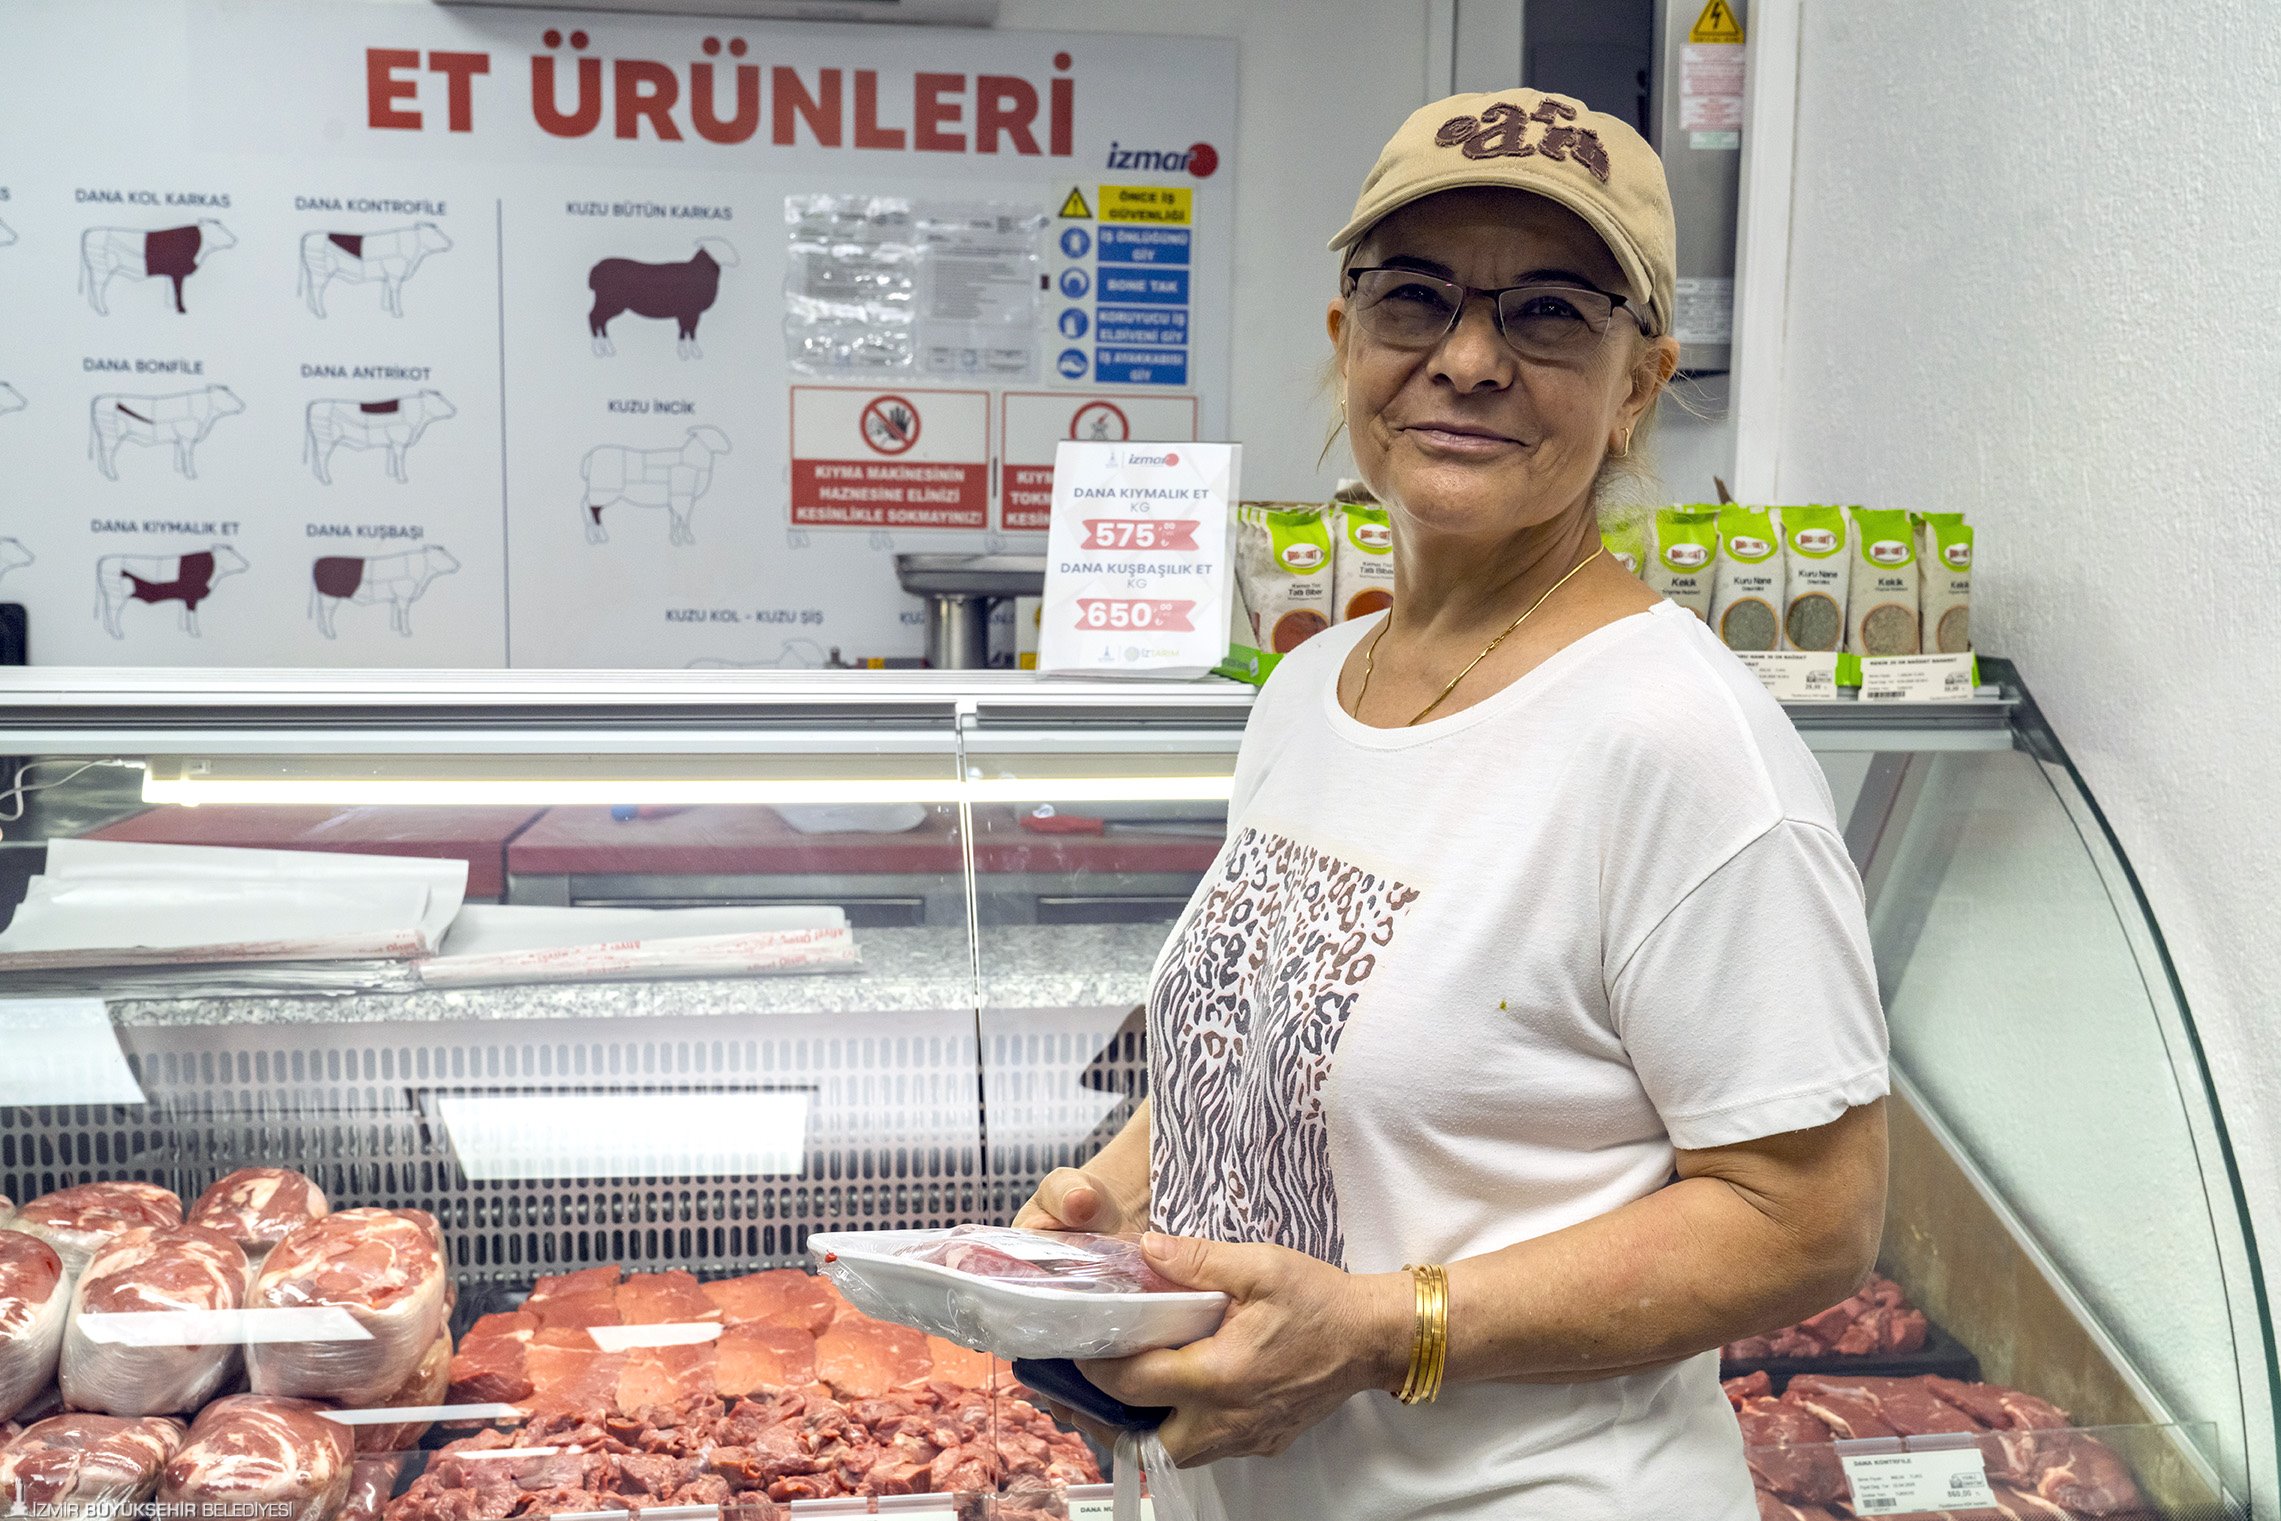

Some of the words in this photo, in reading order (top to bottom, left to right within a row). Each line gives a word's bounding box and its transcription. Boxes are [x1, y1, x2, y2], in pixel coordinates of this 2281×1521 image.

[366, 47, 491, 133] ET
[530, 29, 1075, 158] ÜRÜNLERİ
[74, 187, 125, 204] DANA
[127, 190, 162, 206] KOL
[164, 192, 232, 209] KARKAS
[294, 195, 343, 211] DANA
[347, 197, 447, 216] KONTROFİLE
[565, 201, 609, 217] KUZU
[611, 200, 667, 219] BÜTÜN
[669, 203, 734, 221] KARKAS
[82, 356, 132, 373] DANA
[134, 357, 204, 375] BONFİLE
[300, 363, 348, 379] DANA
[351, 364, 432, 382] ANTRİKOT
[606, 400, 651, 415] KUZU
[652, 397, 697, 416] İNCİK
[814, 465, 865, 481] KIYMA
[865, 466, 966, 483] MAKİNESİNİN
[1015, 471, 1054, 487] KIYM
[818, 486, 905, 502] HAZNESİNE
[1073, 487, 1117, 499] DANA
[1119, 487, 1190, 500] KIYMALIK
[1192, 488, 1210, 500] ET
[796, 506, 884, 523] KESİNLİKLE
[1129, 501, 1151, 513] KG
[90, 518, 139, 534] DANA
[142, 519, 217, 536] KIYMALIK
[220, 520, 242, 536] ET
[305, 523, 353, 538] DANA
[355, 523, 425, 541] KUŞBAŞI
[1060, 562, 1104, 574] DANA
[1106, 563, 1192, 578] KUŞBAŞILIK
[1195, 564, 1213, 575] ET
[1127, 578, 1148, 589] KG
[664, 608, 708, 624] KUZU
[709, 608, 741, 624] KOL
[755, 609, 798, 625] KUZU
